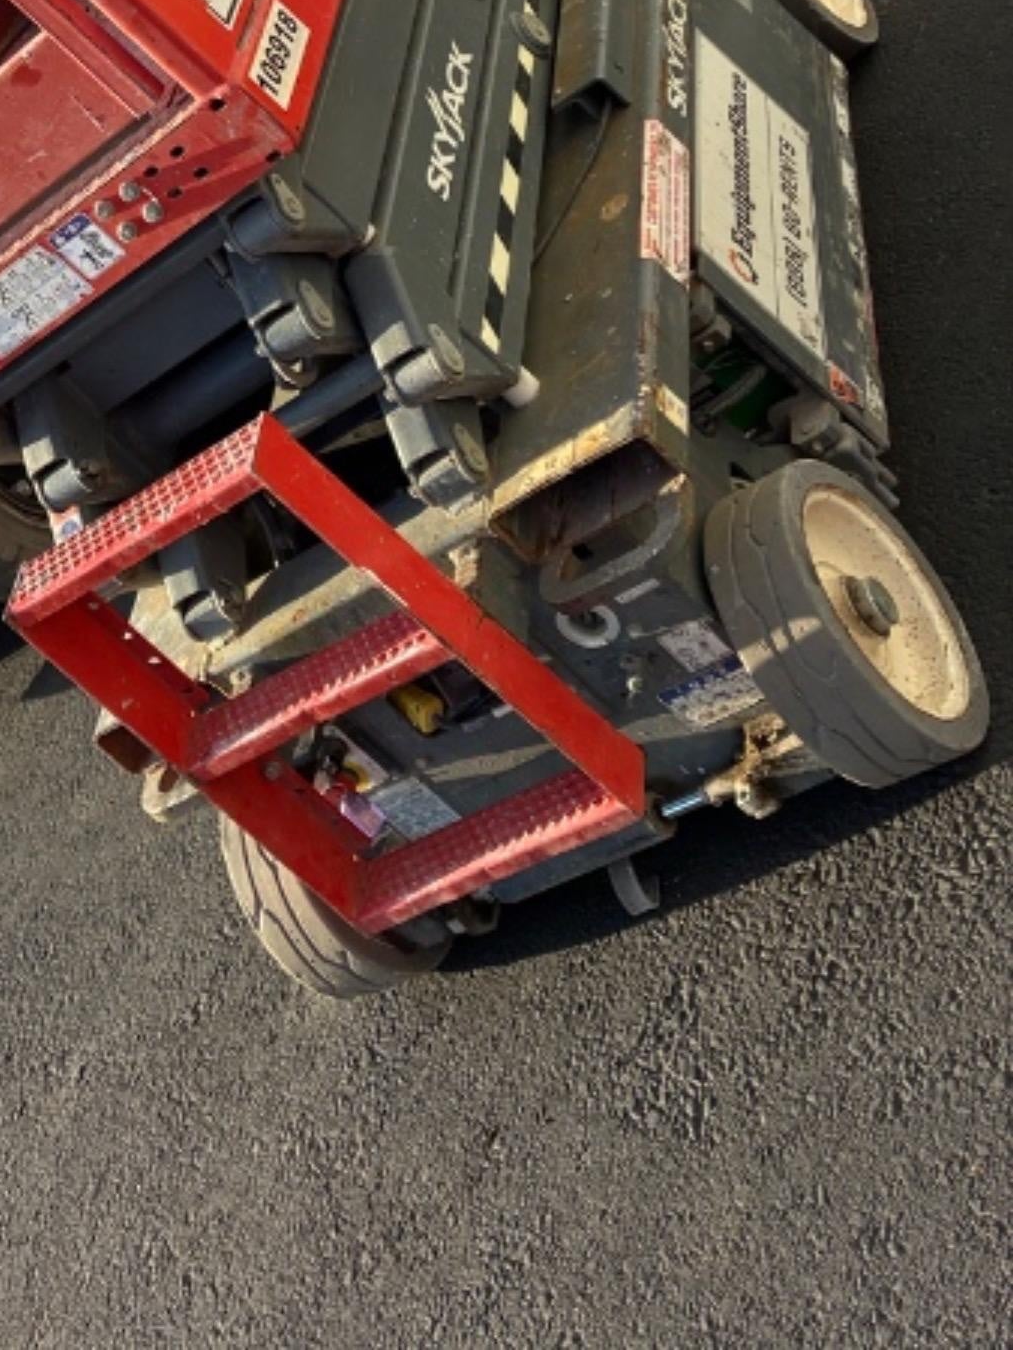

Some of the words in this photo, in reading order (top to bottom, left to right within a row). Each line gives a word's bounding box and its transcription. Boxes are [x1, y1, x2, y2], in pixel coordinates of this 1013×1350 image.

[256, 9, 298, 96] 106918
[425, 40, 474, 202] SKYJACK
[728, 71, 757, 258] EquipmentShare
